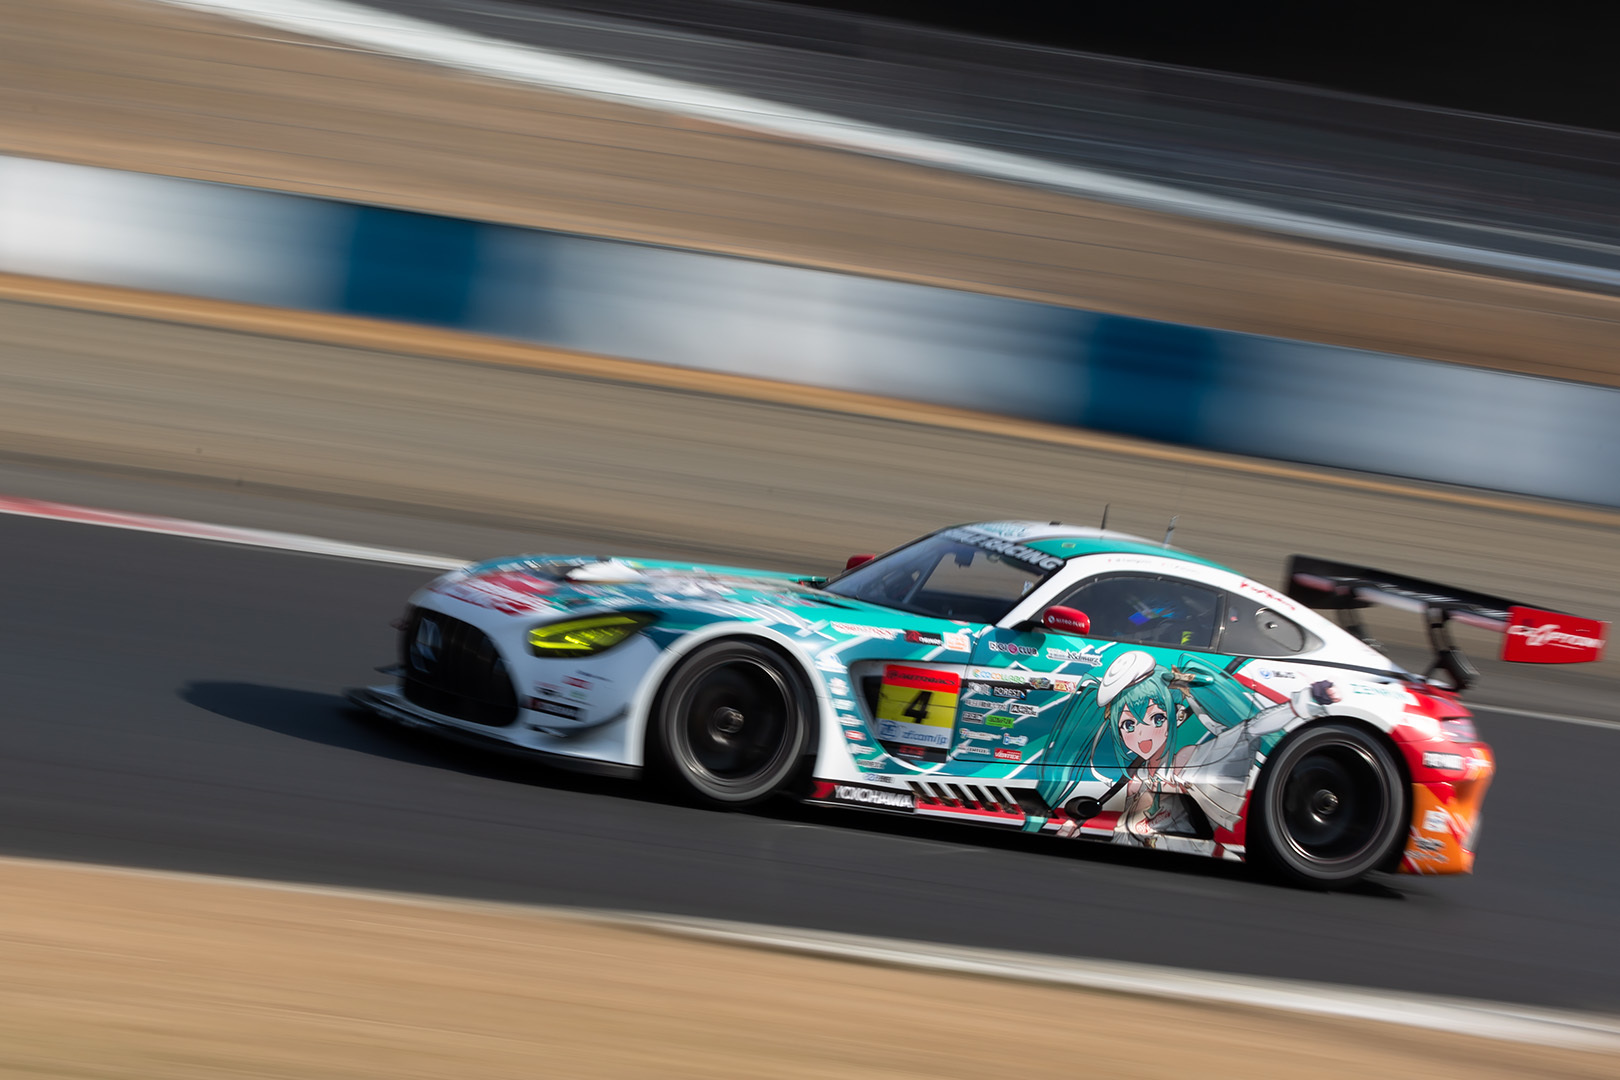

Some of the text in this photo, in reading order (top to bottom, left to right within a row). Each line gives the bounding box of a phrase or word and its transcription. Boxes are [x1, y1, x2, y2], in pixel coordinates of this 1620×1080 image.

[985, 539, 1065, 571] RACING
[1018, 646, 1038, 656] CLUB
[994, 686, 1022, 697] FOREST
[901, 690, 935, 724] 4
[834, 784, 915, 808] YOKOHAMA
